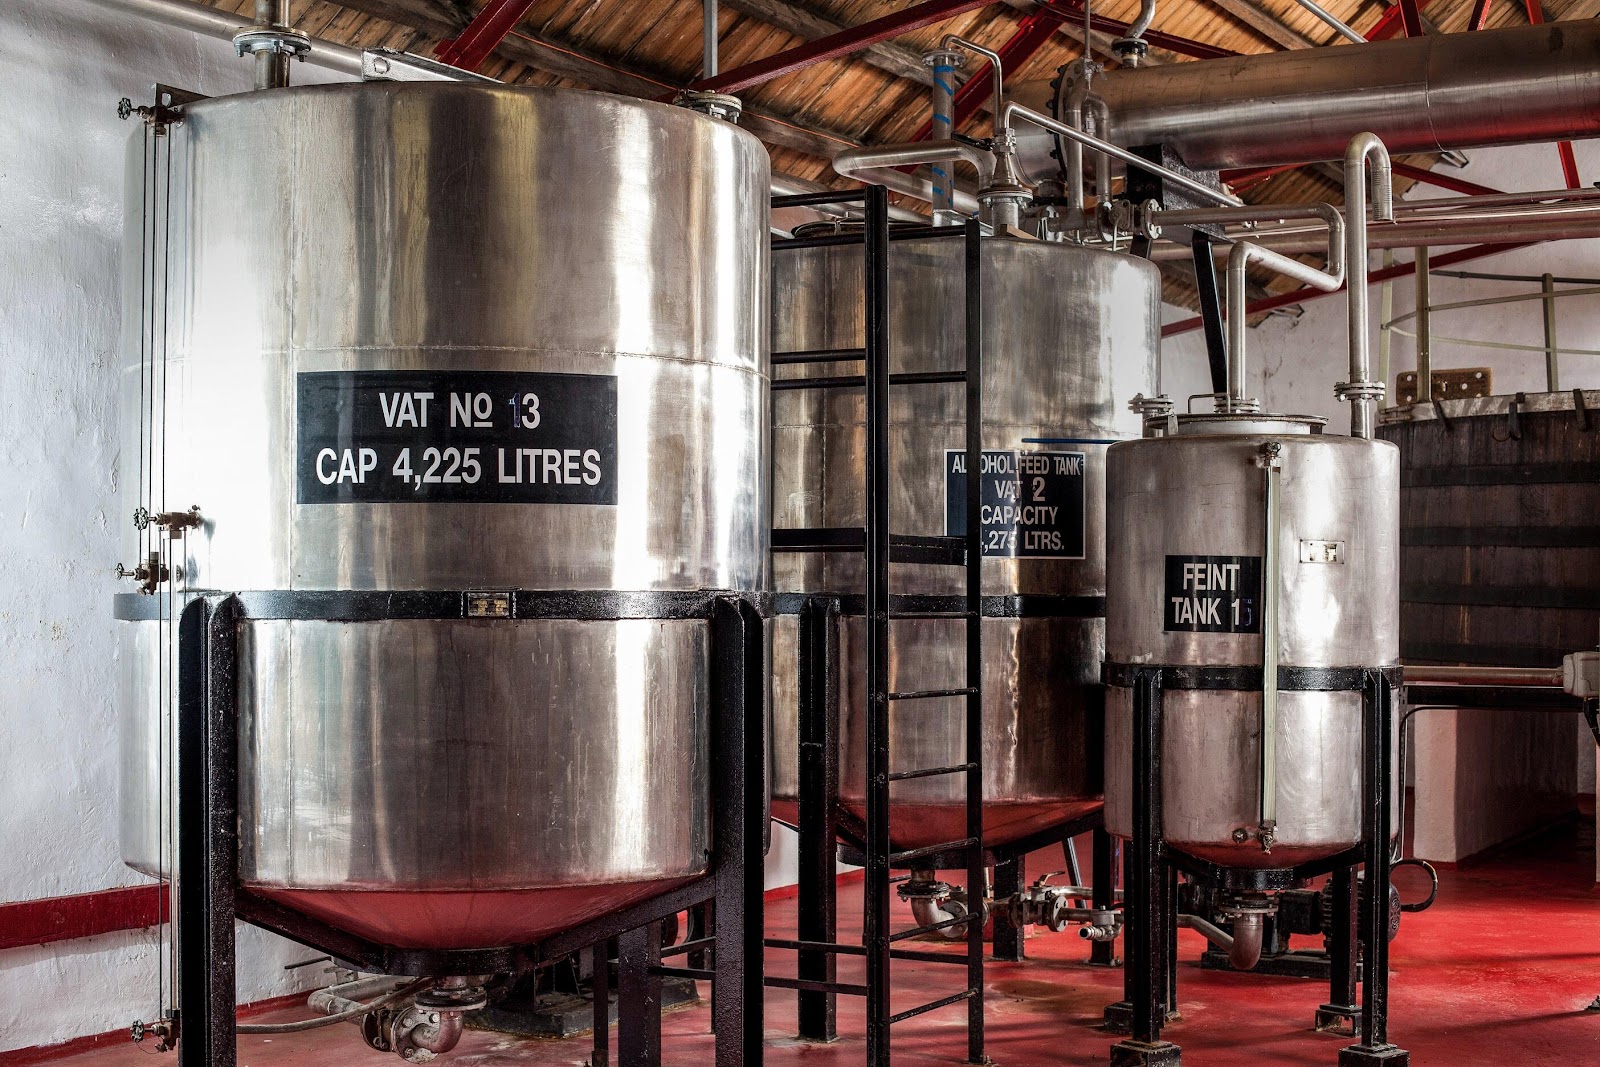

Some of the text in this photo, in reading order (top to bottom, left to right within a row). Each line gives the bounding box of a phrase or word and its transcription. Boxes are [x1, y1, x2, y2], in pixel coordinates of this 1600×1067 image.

[379, 392, 434, 427] VAT
[509, 392, 541, 429] 13
[315, 447, 602, 491] CAP 4,225 LITRES
[952, 454, 1081, 475] ALOHOL FEED TANK
[994, 476, 1046, 502] VAT 2
[981, 505, 1059, 525] CAPACITY
[981, 530, 1065, 553] ,275 LTRS.
[1183, 563, 1240, 591] FEINT
[1171, 597, 1222, 625] TANK
